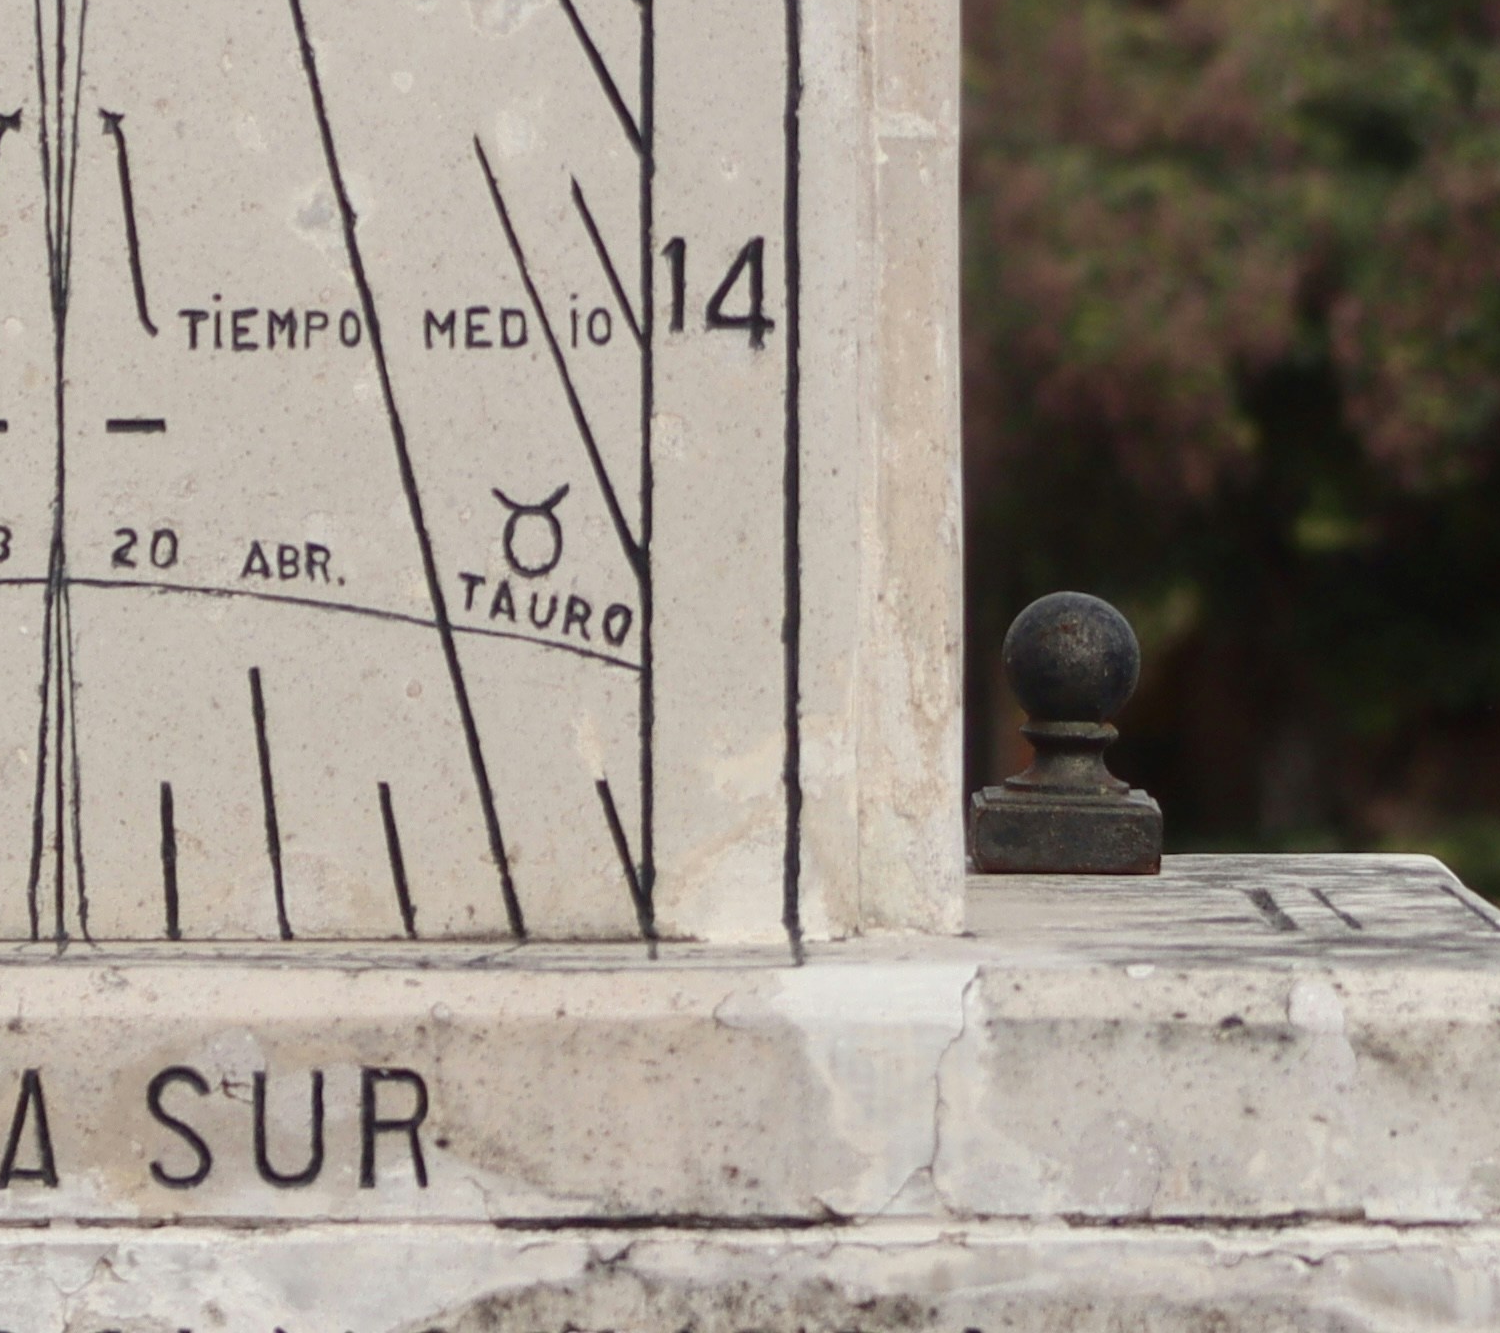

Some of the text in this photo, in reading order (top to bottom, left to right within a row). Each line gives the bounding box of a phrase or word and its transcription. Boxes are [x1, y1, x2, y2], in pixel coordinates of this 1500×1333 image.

[661, 235, 775, 350] 14
[111, 528, 346, 587] 20 ABR.
[459, 572, 634, 647] TAURO
[146, 1064, 432, 1191] SUR
